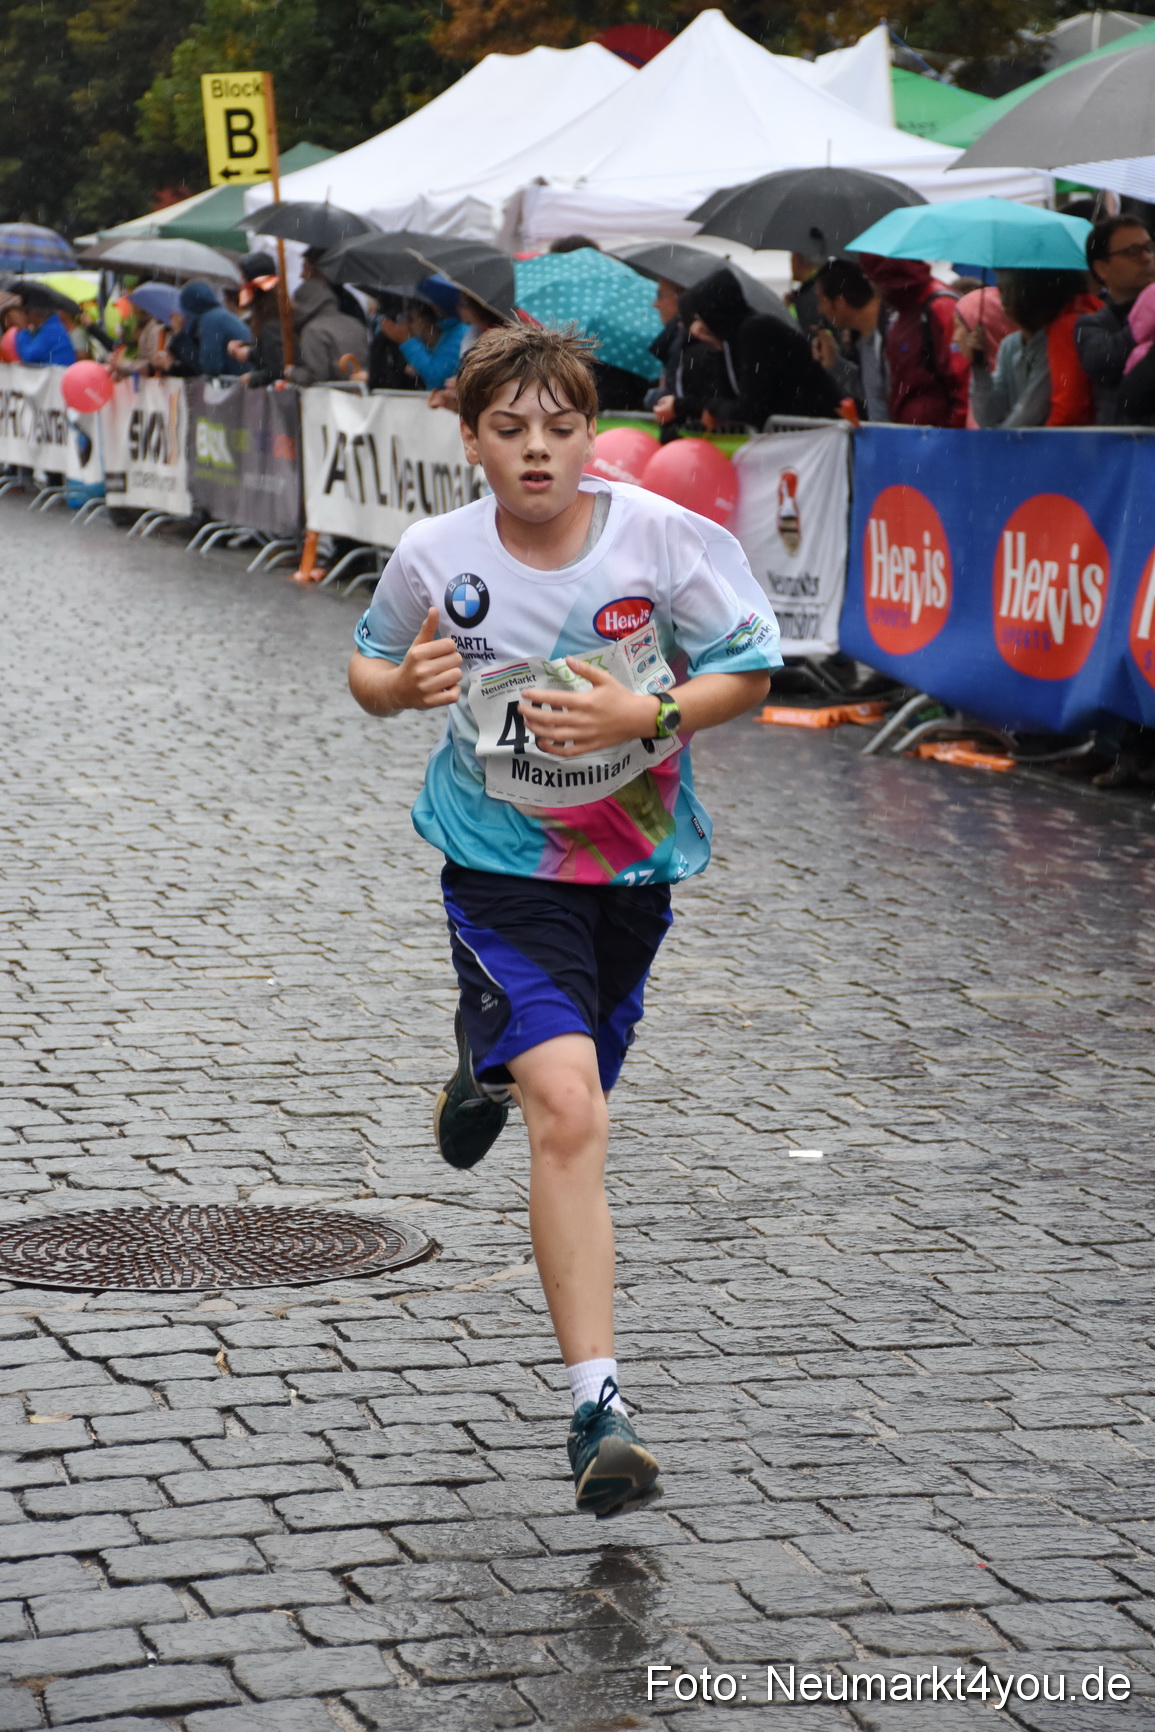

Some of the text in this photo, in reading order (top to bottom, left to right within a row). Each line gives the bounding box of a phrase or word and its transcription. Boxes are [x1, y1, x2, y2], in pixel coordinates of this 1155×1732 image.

[211, 78, 266, 98] Block
[224, 108, 258, 159] B
[869, 518, 947, 624] Hervis
[447, 574, 486, 593] BMW
[999, 530, 1104, 645] Hervis
[605, 608, 650, 630] Hervis
[459, 651, 496, 660] umarkt
[481, 674, 537, 697] NeuerMarkt
[511, 753, 631, 788] Maximilian
